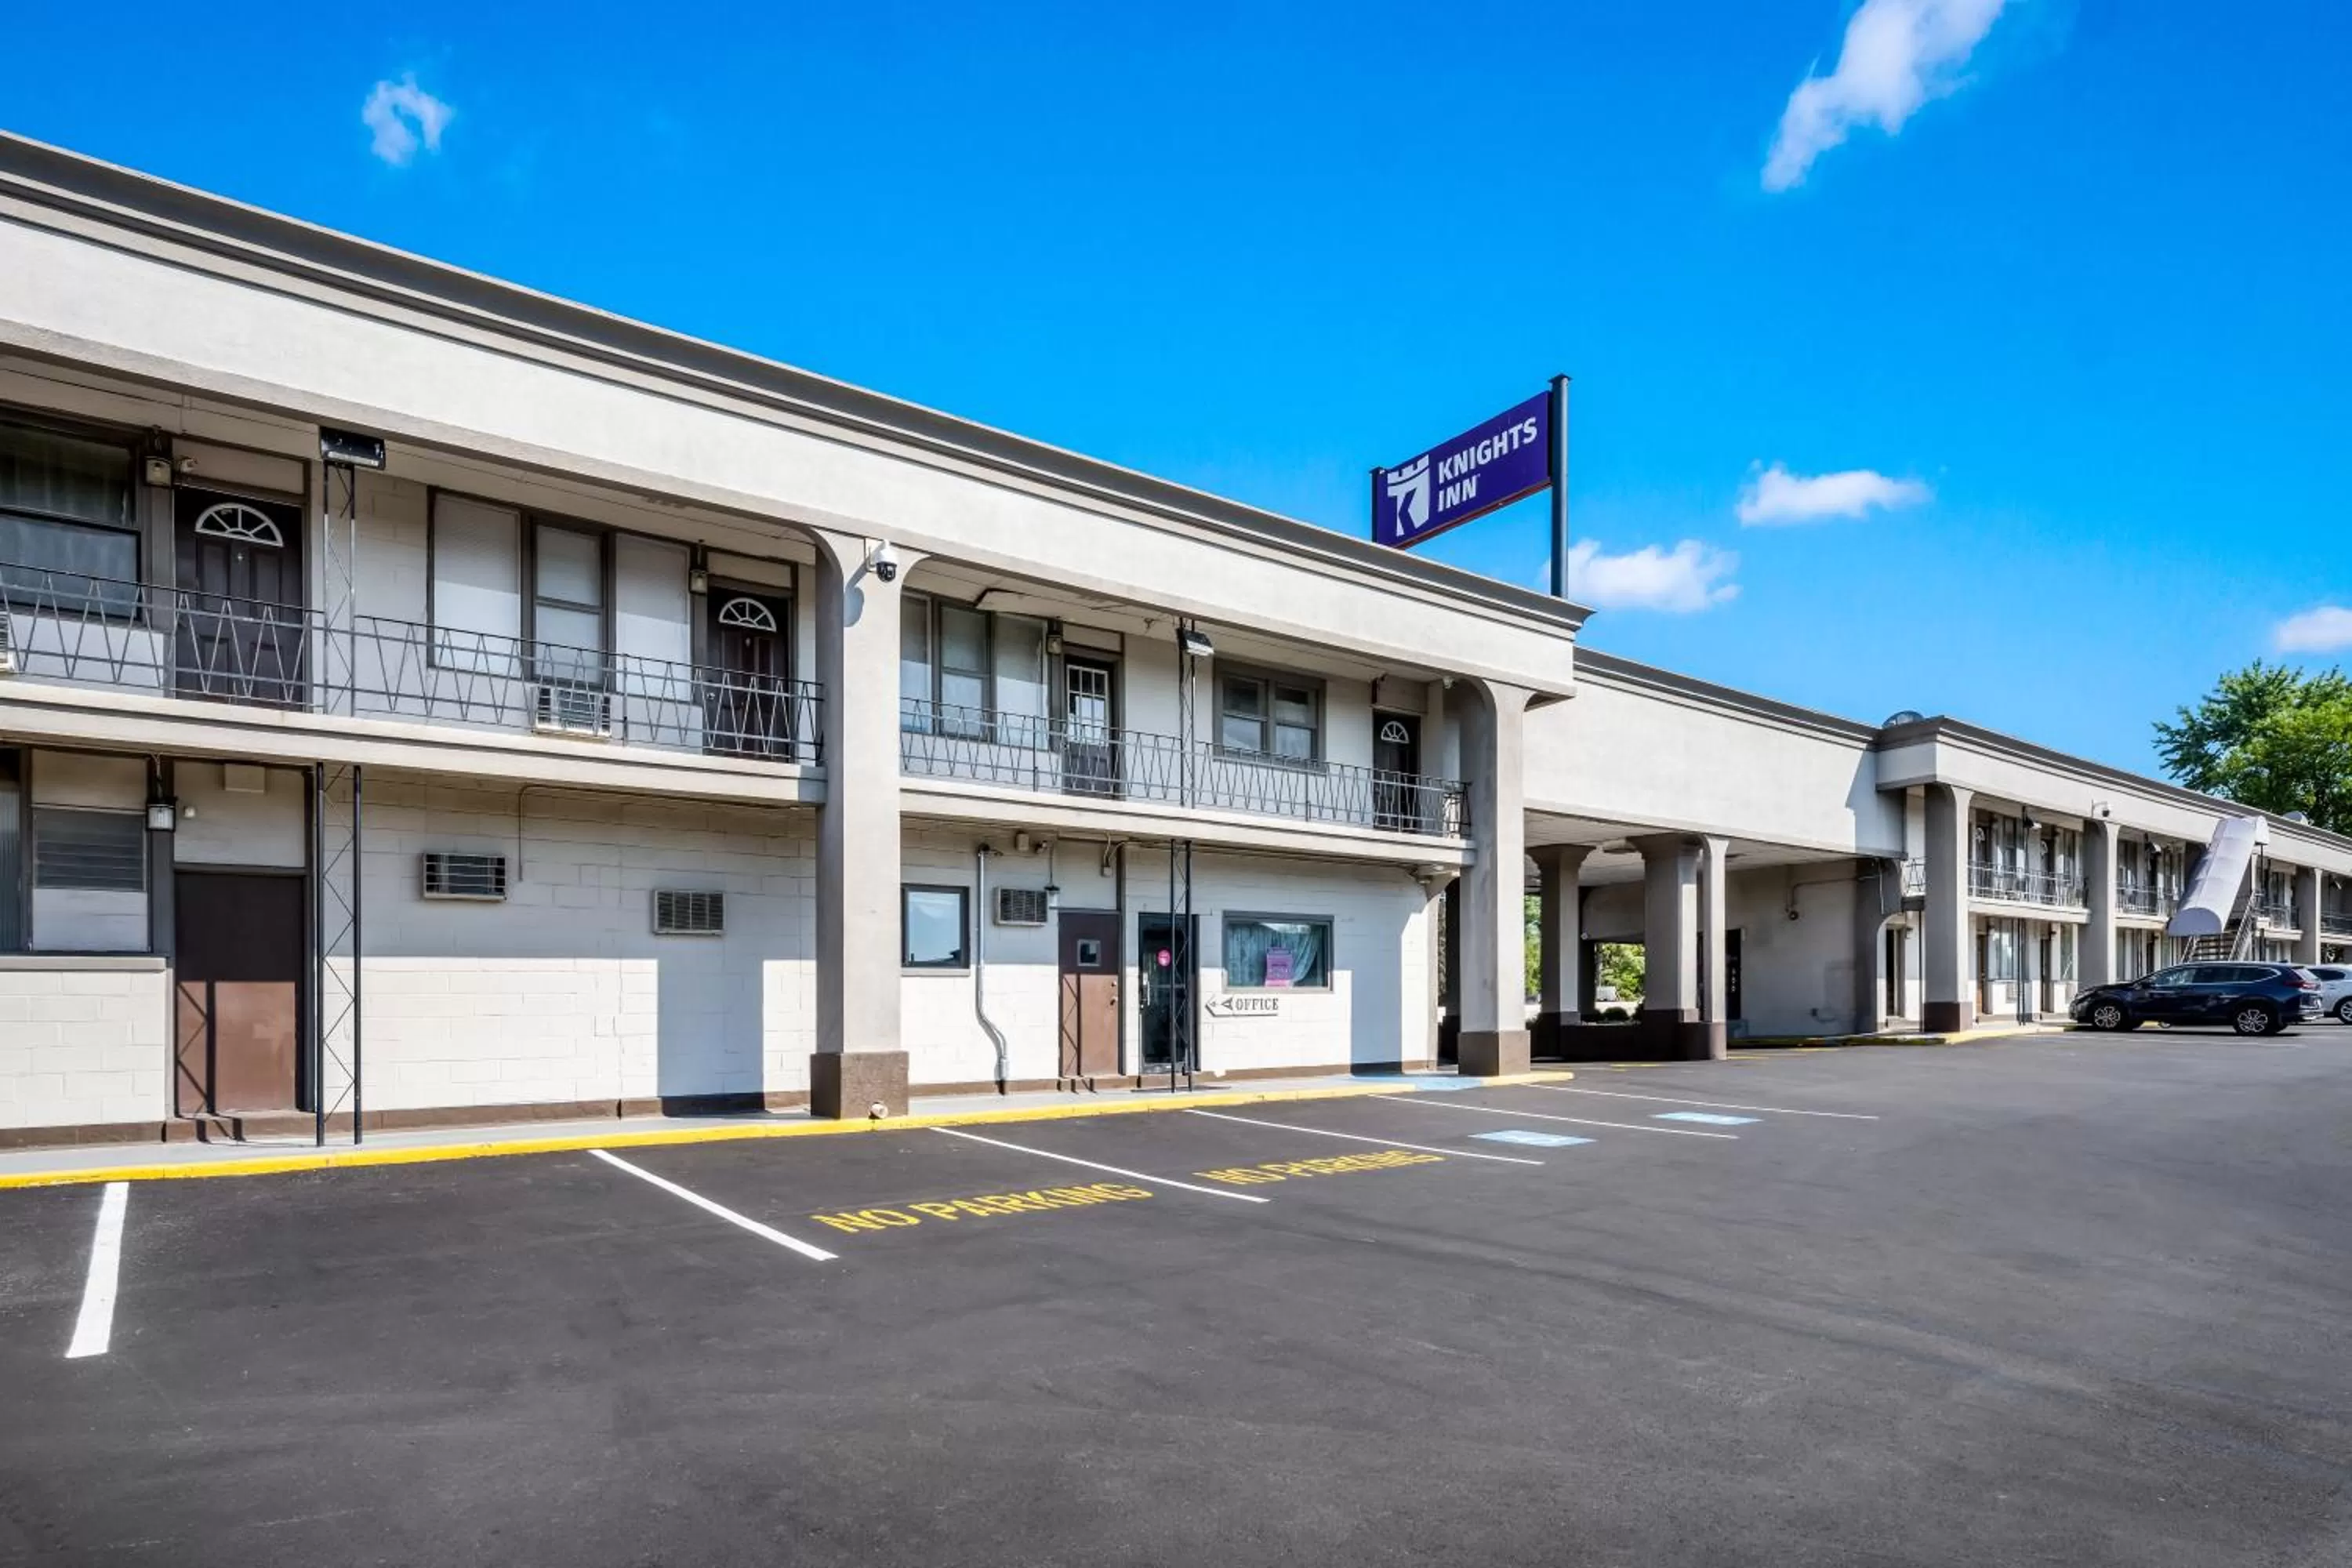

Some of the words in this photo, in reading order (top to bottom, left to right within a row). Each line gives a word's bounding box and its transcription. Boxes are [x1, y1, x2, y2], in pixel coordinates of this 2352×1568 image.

[1438, 416, 1537, 484] KNIGHTS
[1437, 476, 1477, 512] INN
[1235, 998, 1279, 1011] OFFICE
[1192, 1167, 1287, 1185] NO
[811, 1209, 921, 1233] NO
[908, 1183, 1153, 1221] PARKING
